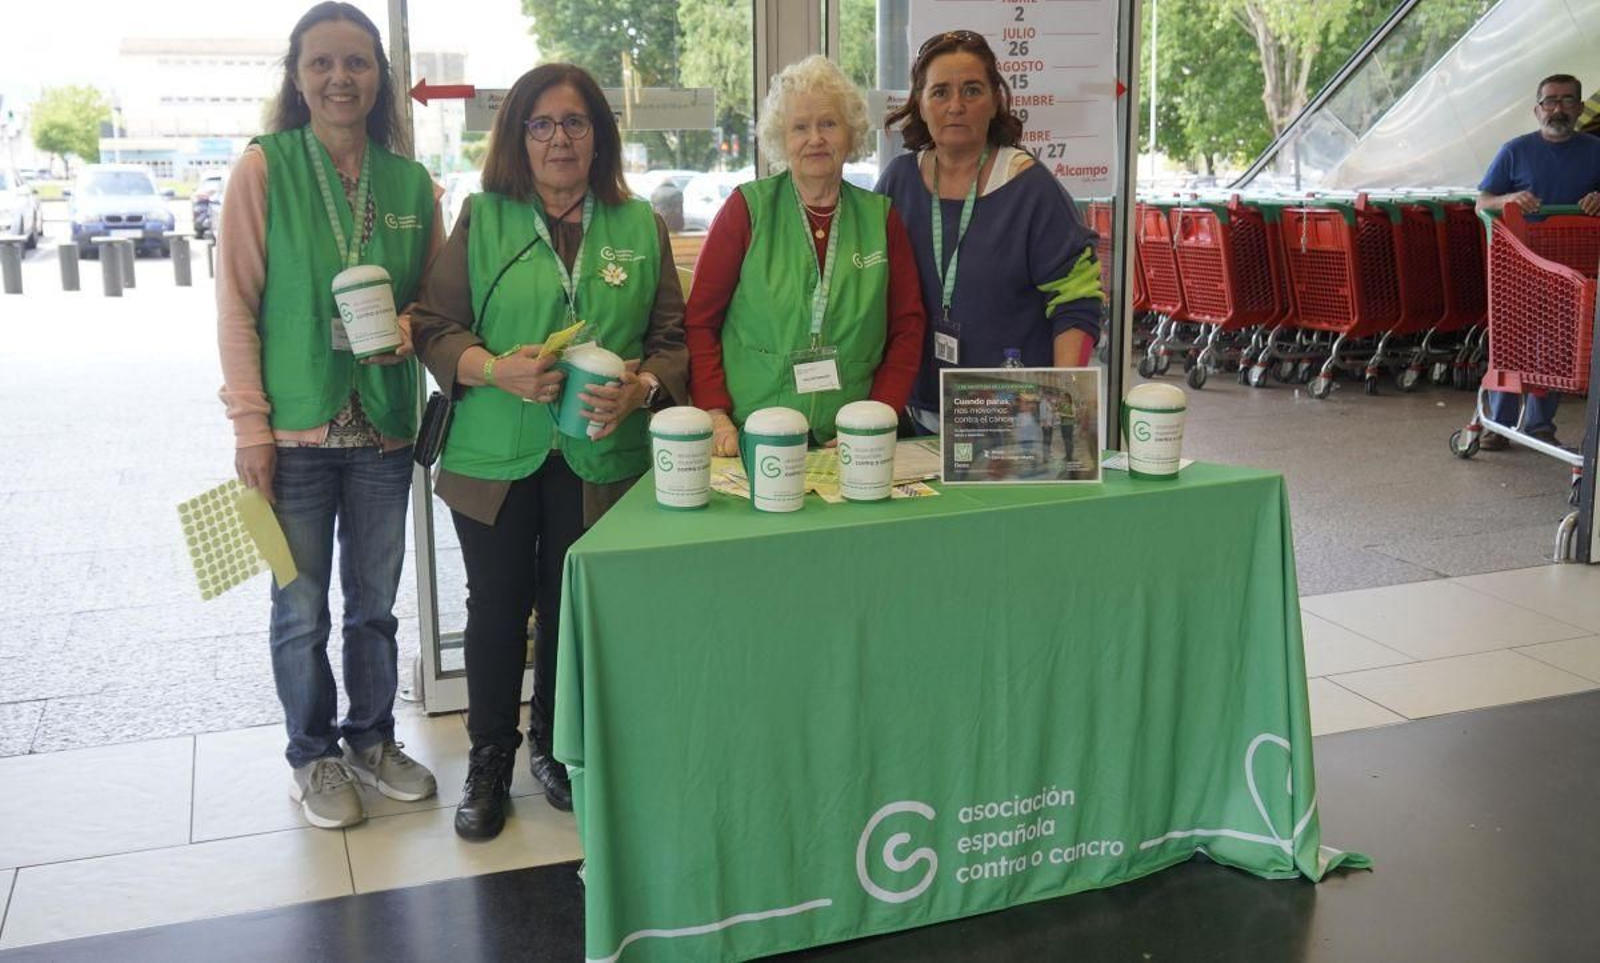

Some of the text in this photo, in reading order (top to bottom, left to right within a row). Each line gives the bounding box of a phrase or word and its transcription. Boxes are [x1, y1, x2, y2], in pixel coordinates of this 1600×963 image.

[1014, 6, 1025, 21] 2
[1002, 27, 1036, 41] JULIO
[1008, 41, 1029, 56] 26
[995, 61, 1044, 72] AGOSTO
[1009, 74, 1028, 89] 15
[1010, 95, 1054, 106] IEMBRE
[1047, 143, 1066, 158] 27
[1055, 162, 1108, 177] Alcampo
[954, 416, 979, 424] contra
[958, 785, 1075, 824] asociación
[957, 818, 1055, 854] española
[956, 839, 1124, 884] contra o cancro
